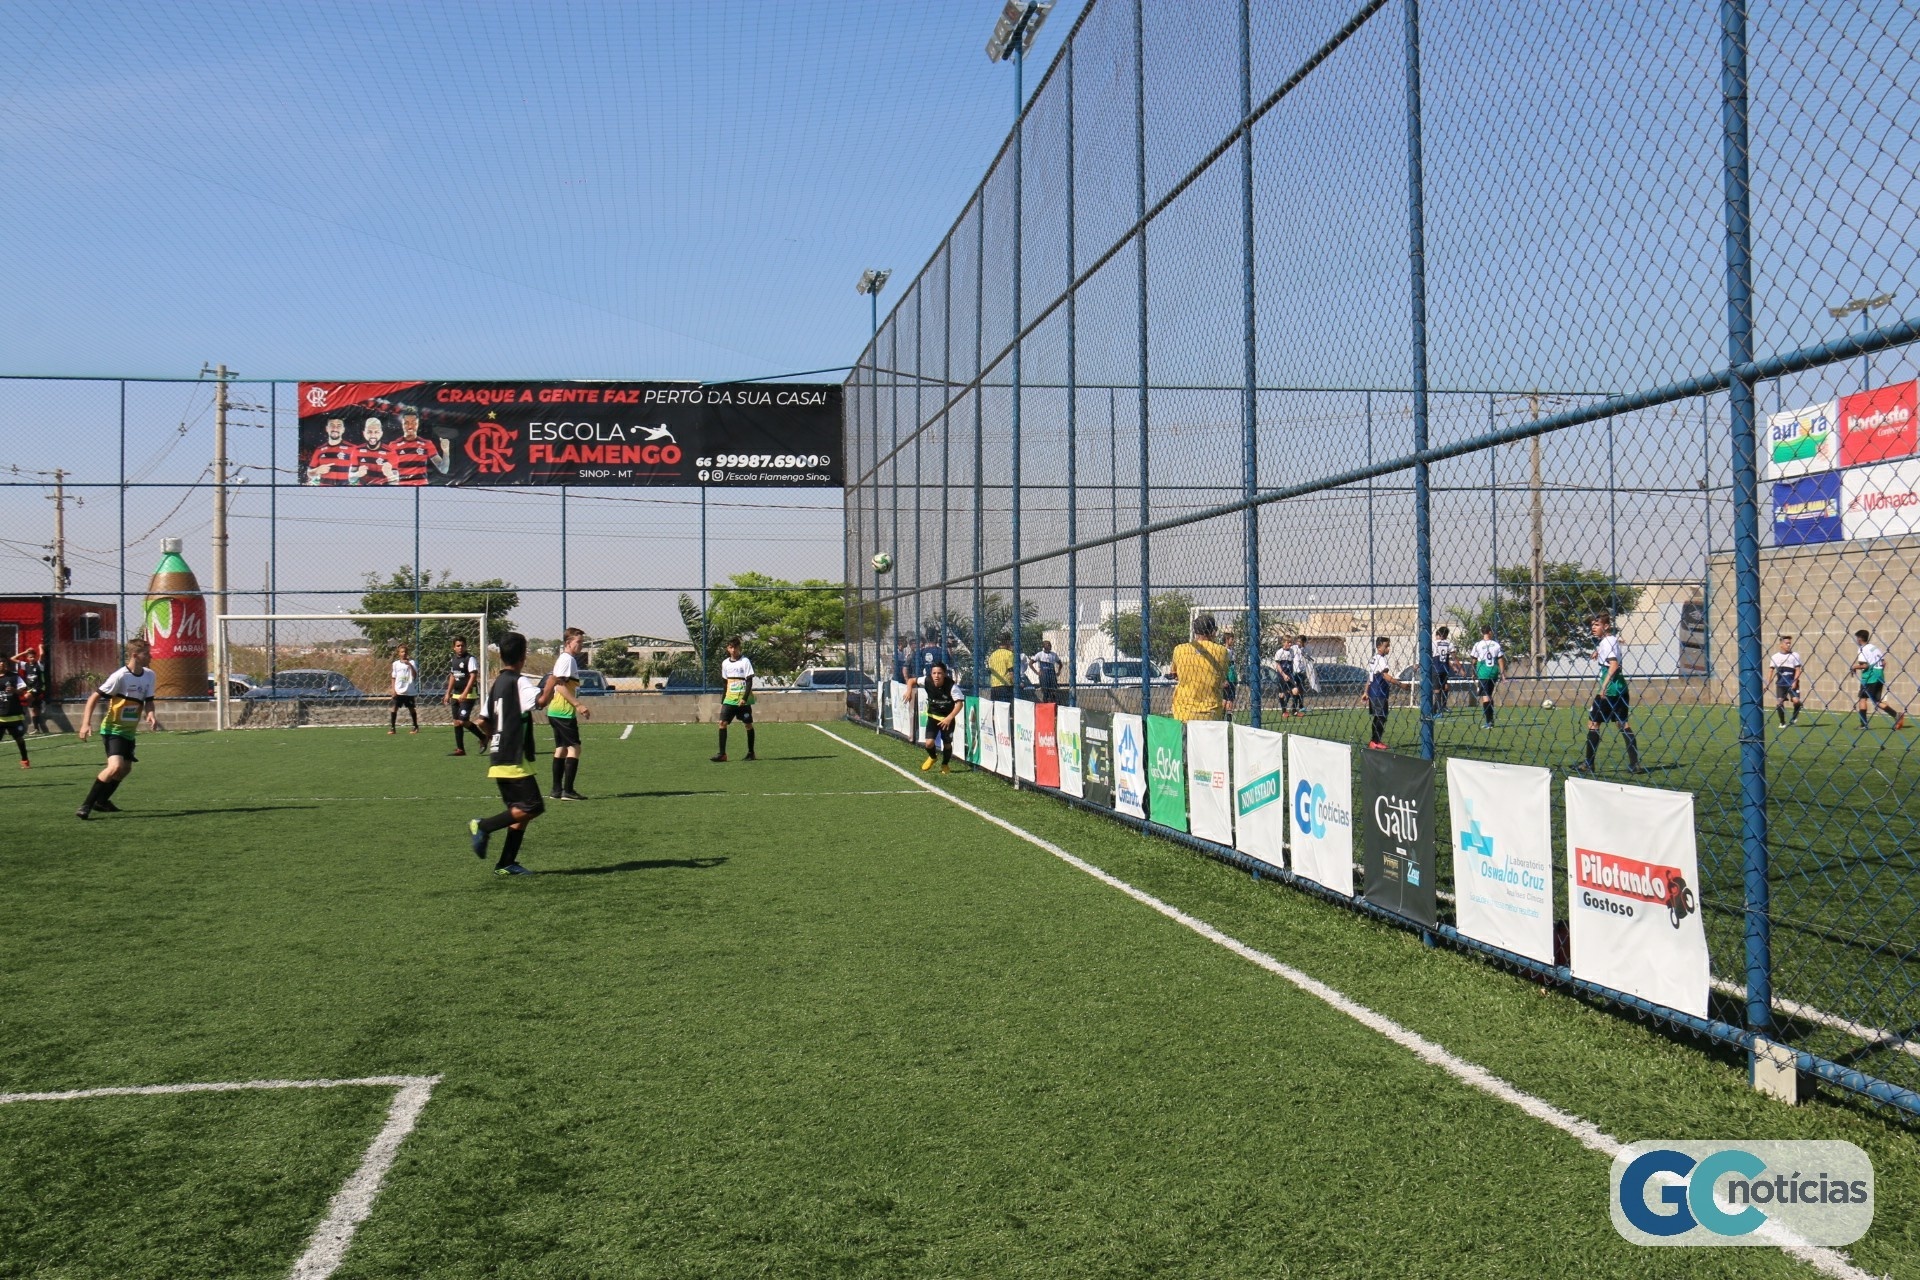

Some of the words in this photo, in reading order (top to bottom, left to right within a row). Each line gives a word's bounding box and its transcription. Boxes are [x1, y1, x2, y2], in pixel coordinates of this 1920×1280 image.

[437, 388, 515, 405] CRAQUE
[516, 389, 532, 403] A
[539, 389, 599, 404] GENTE
[603, 389, 641, 404] FAZ
[644, 389, 704, 405] PERTO
[707, 390, 732, 405] DA
[736, 391, 771, 406] SUA
[776, 391, 827, 406] CASA!
[529, 422, 626, 441] ESCOLA
[529, 444, 681, 465] FLAMENGO
[696, 457, 712, 467] 66
[716, 454, 818, 468] 99987.6900
[579, 469, 610, 479] SINOP
[618, 470, 632, 479] MT
[760, 472, 805, 483] Flamengo
[806, 473, 830, 482] Sinop
[1295, 779, 1326, 840] GC
[1318, 801, 1350, 827] notícias
[1374, 795, 1418, 843] Gatti
[1481, 853, 1519, 885] Oswaldo
[1522, 870, 1545, 891] Cruz
[1579, 853, 1666, 900] Pilotando
[1583, 891, 1634, 918] Gostoso
